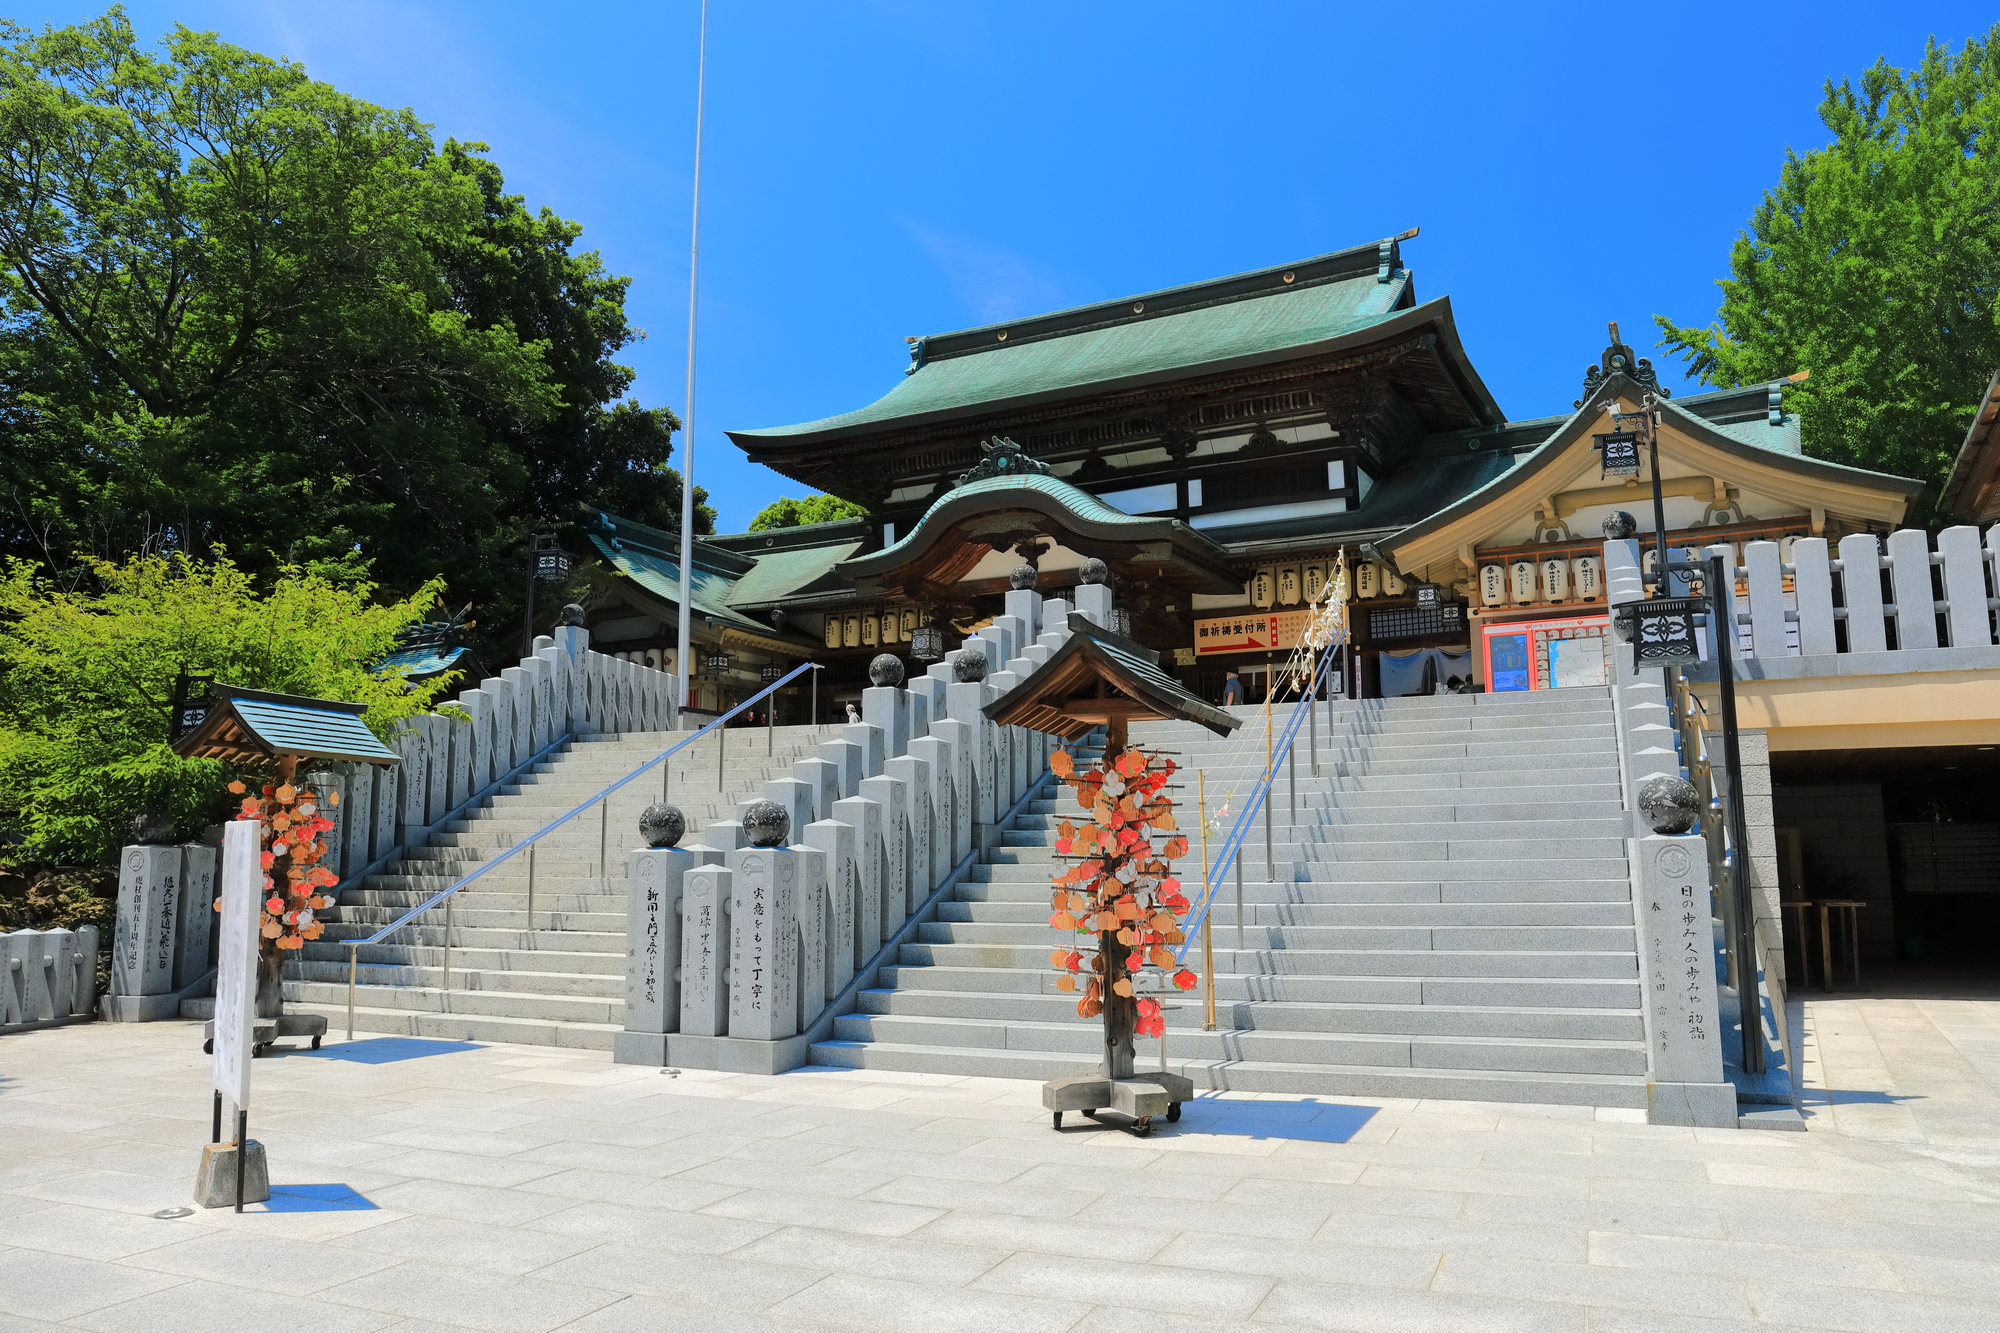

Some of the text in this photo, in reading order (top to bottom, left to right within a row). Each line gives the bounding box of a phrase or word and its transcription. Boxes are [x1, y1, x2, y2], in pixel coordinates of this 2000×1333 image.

[128, 876, 143, 970] 虎杖創刊五十周年記念
[752, 887, 764, 1010] 実意をもって丁寧に
[1681, 885, 1705, 1040] 日の歩み人の歩みや初詣
